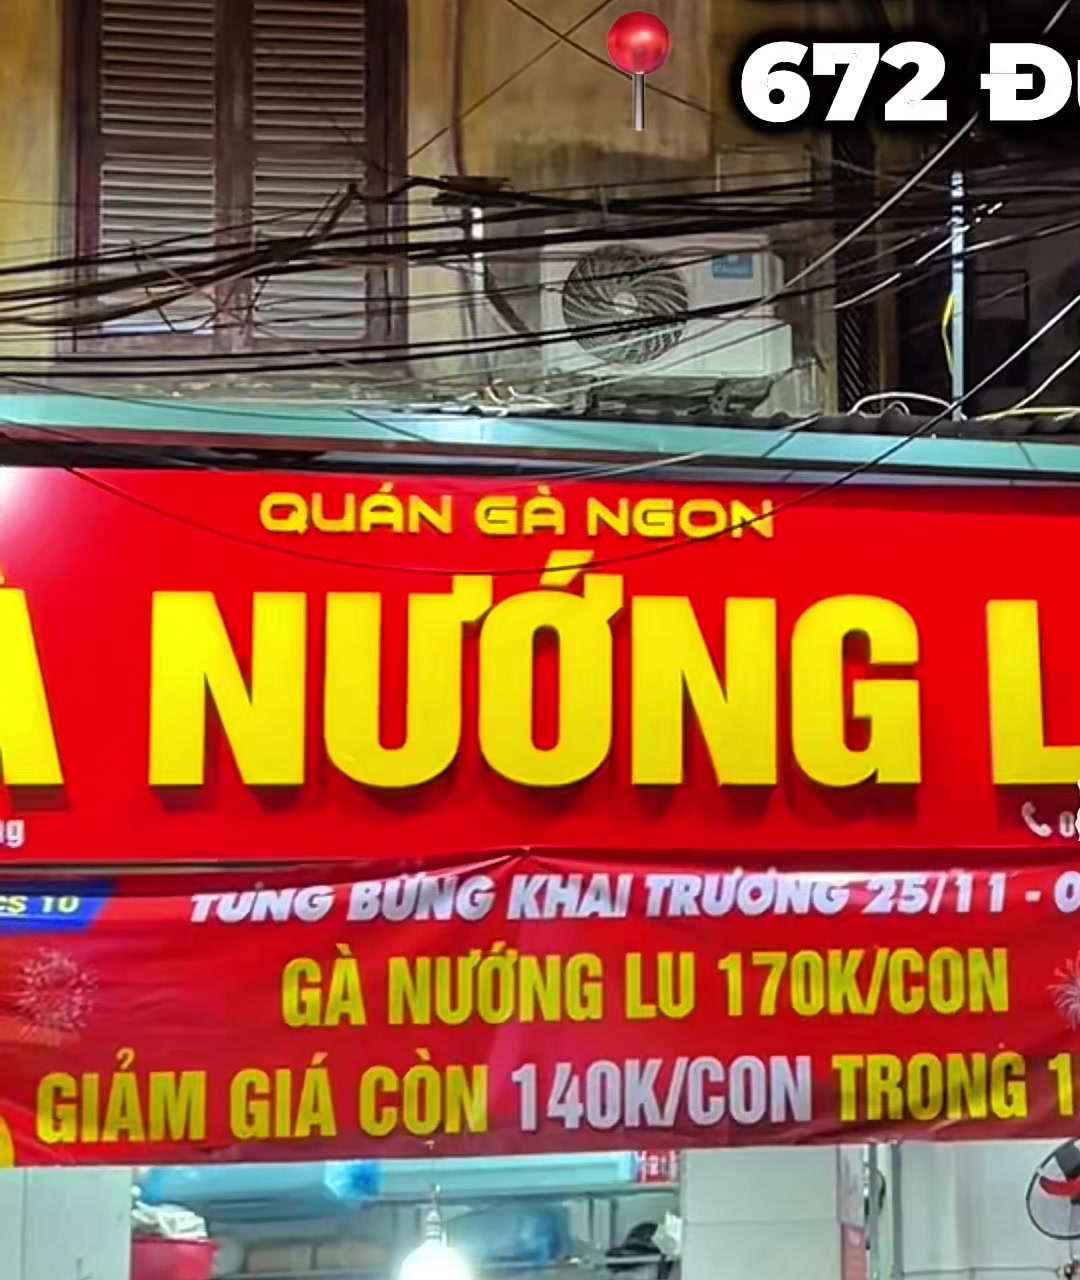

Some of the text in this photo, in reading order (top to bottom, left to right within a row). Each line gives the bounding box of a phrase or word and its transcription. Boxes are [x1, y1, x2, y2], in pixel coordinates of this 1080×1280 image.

[260, 483, 772, 537] QUÁN GÀ NGON
[149, 551, 921, 787] NƯỚNG
[505, 873, 635, 920] KHAI
[861, 870, 1008, 915] 25/11
[282, 942, 1008, 1027] GÀ NƯỚNG LU 170K/CON
[36, 1048, 206, 1144] GIẢM
[230, 1053, 337, 1140] GIÁ
[360, 1048, 488, 1136] CÒN
[510, 1054, 813, 1133] 140K/CON
[832, 1052, 1028, 1123] TRONG
